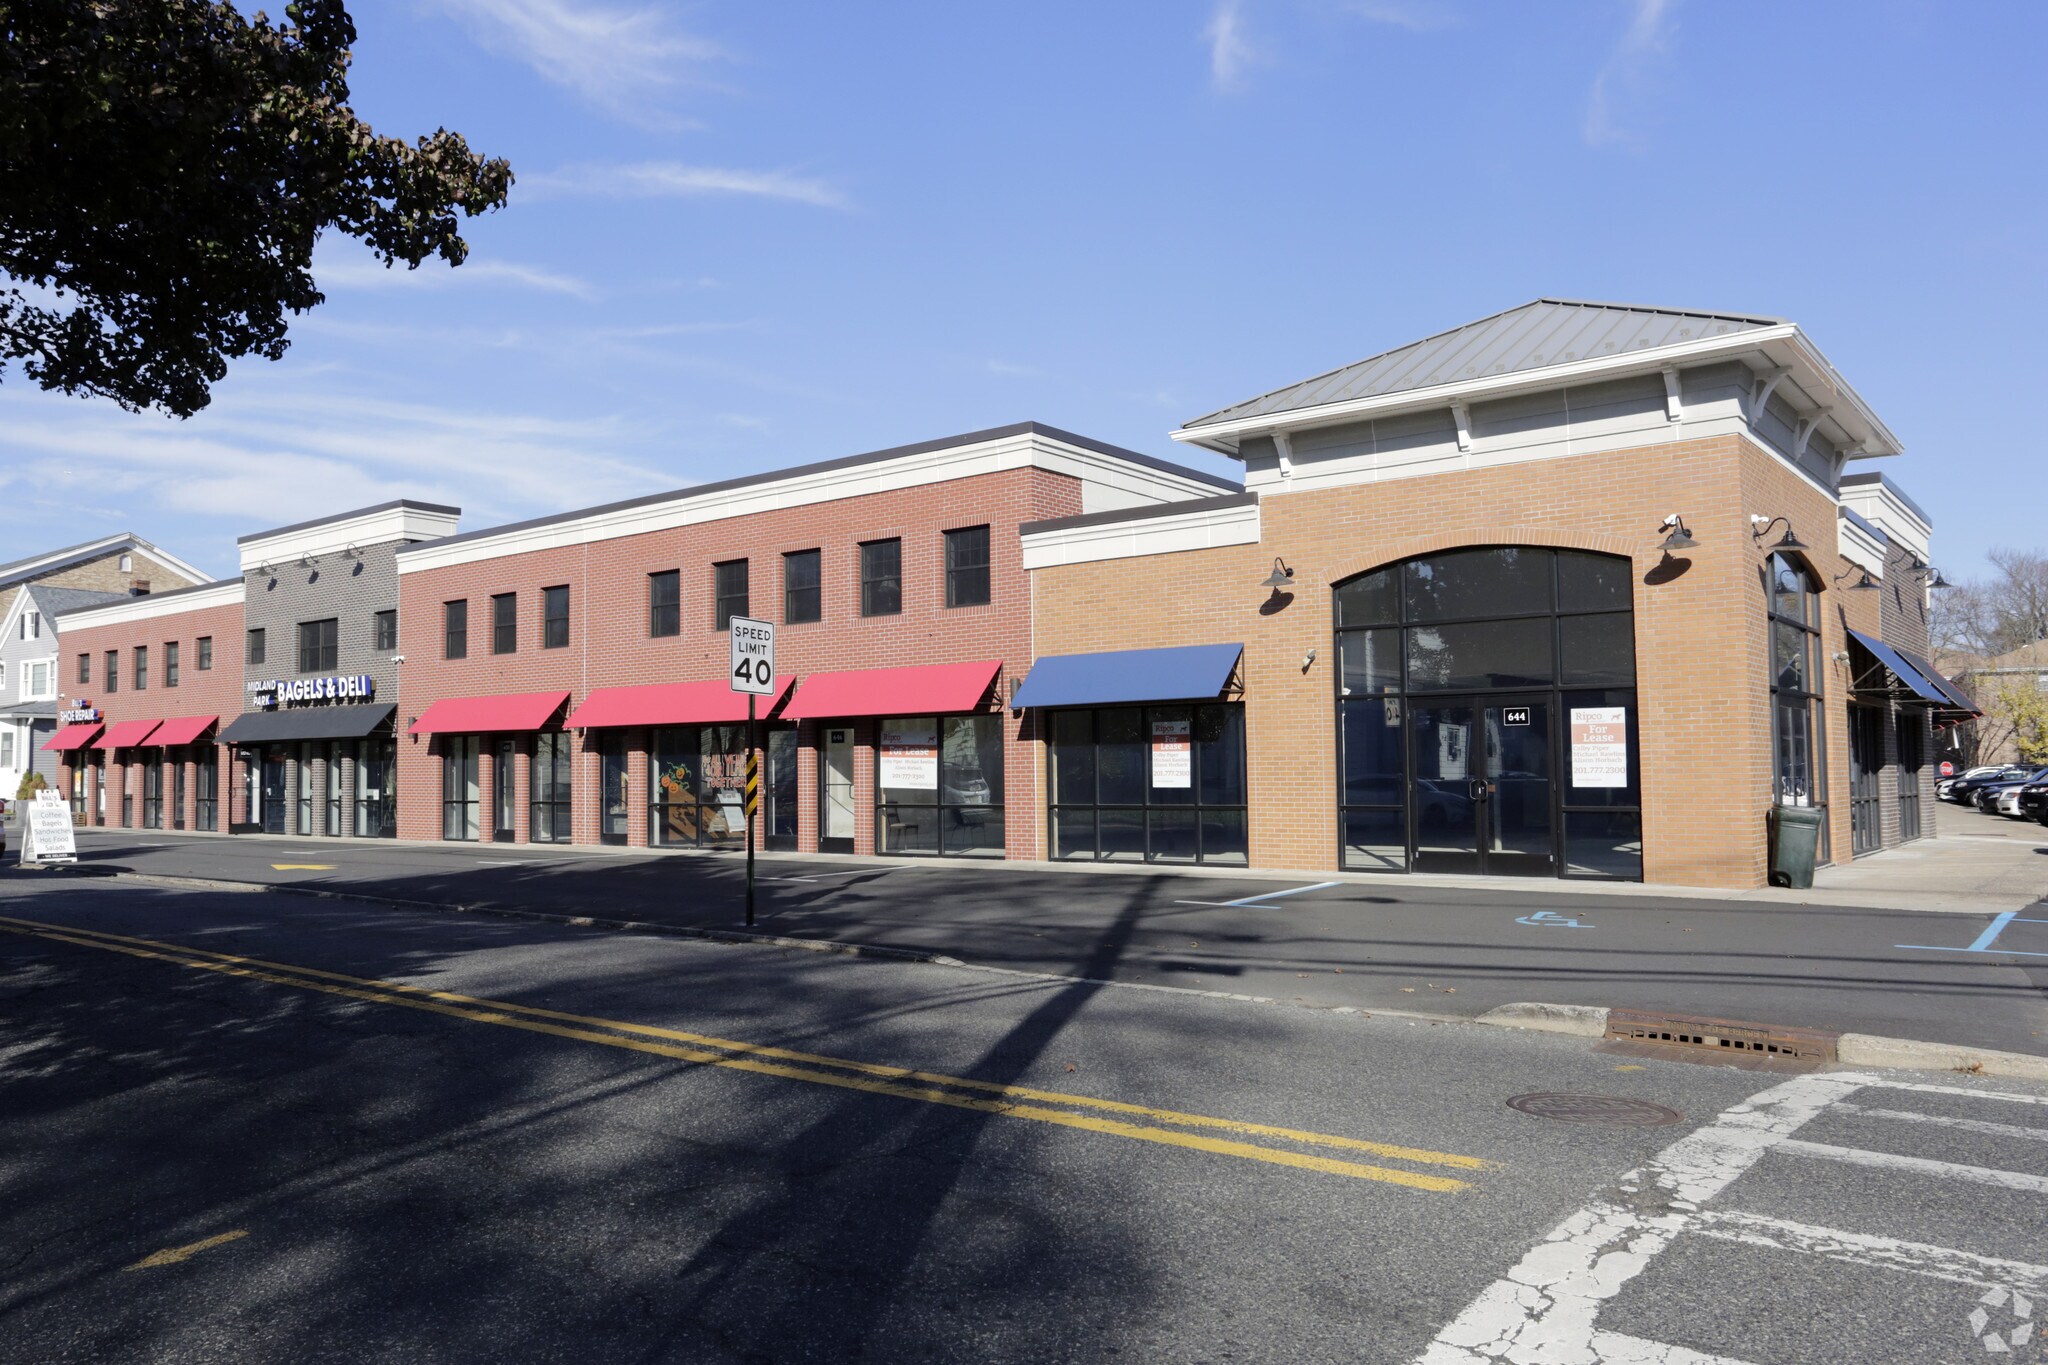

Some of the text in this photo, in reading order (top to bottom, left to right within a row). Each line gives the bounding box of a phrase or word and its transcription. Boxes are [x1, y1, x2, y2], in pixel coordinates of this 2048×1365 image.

[735, 626, 771, 641] SPEED
[738, 641, 767, 655] LIMIT
[734, 657, 771, 686] 40
[247, 679, 276, 692] MIDLAND
[277, 675, 366, 702] BAGELS & DELI
[253, 694, 270, 706] PARK
[60, 709, 95, 722] SHOE REPAIR
[1508, 712, 1526, 721] 644
[1575, 712, 1602, 723] Ripco
[1589, 724, 1608, 734] For
[1582, 733, 1614, 742] Lease
[889, 746, 929, 756] For Lease
[1160, 743, 1183, 751] Lease
[1573, 766, 1626, 774] 201.777.2300
